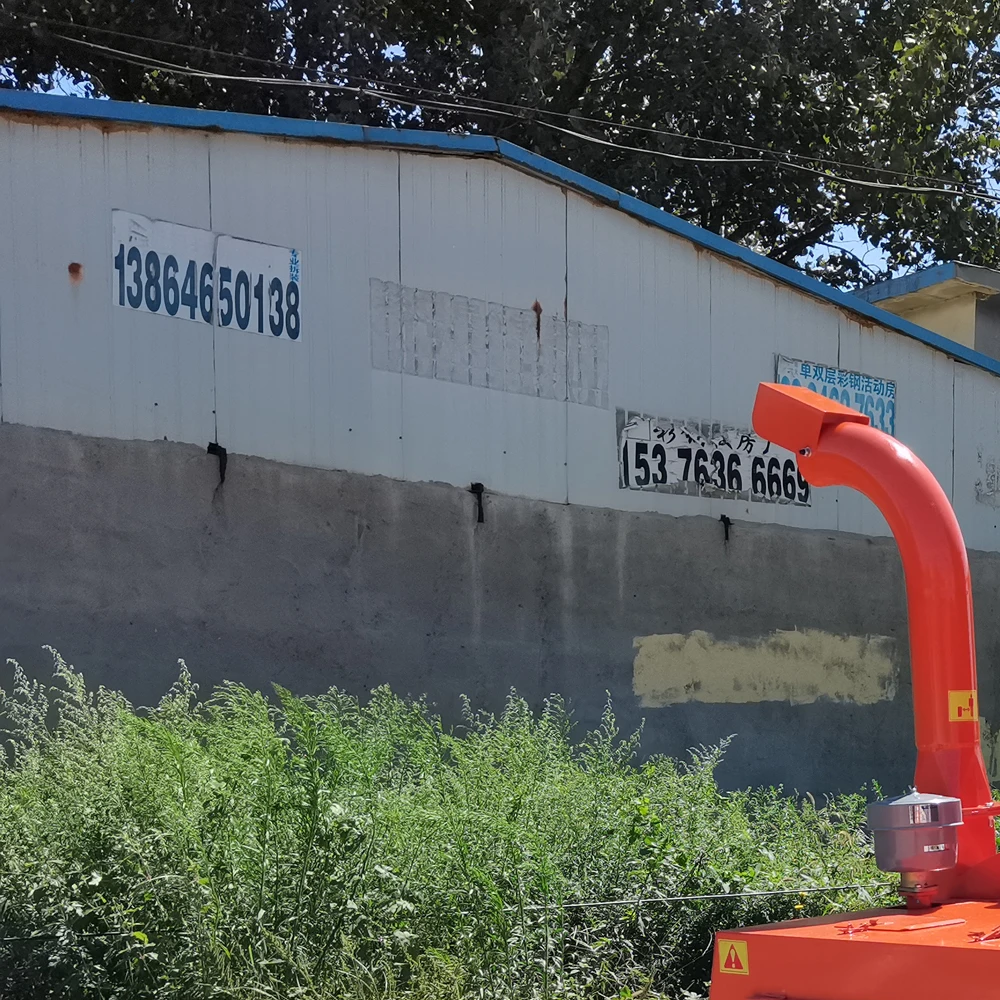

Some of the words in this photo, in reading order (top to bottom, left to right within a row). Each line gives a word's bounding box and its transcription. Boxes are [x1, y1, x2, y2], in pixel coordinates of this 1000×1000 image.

[114, 243, 300, 340] 13864650138
[800, 363, 896, 399] 单双层彩钢活动房
